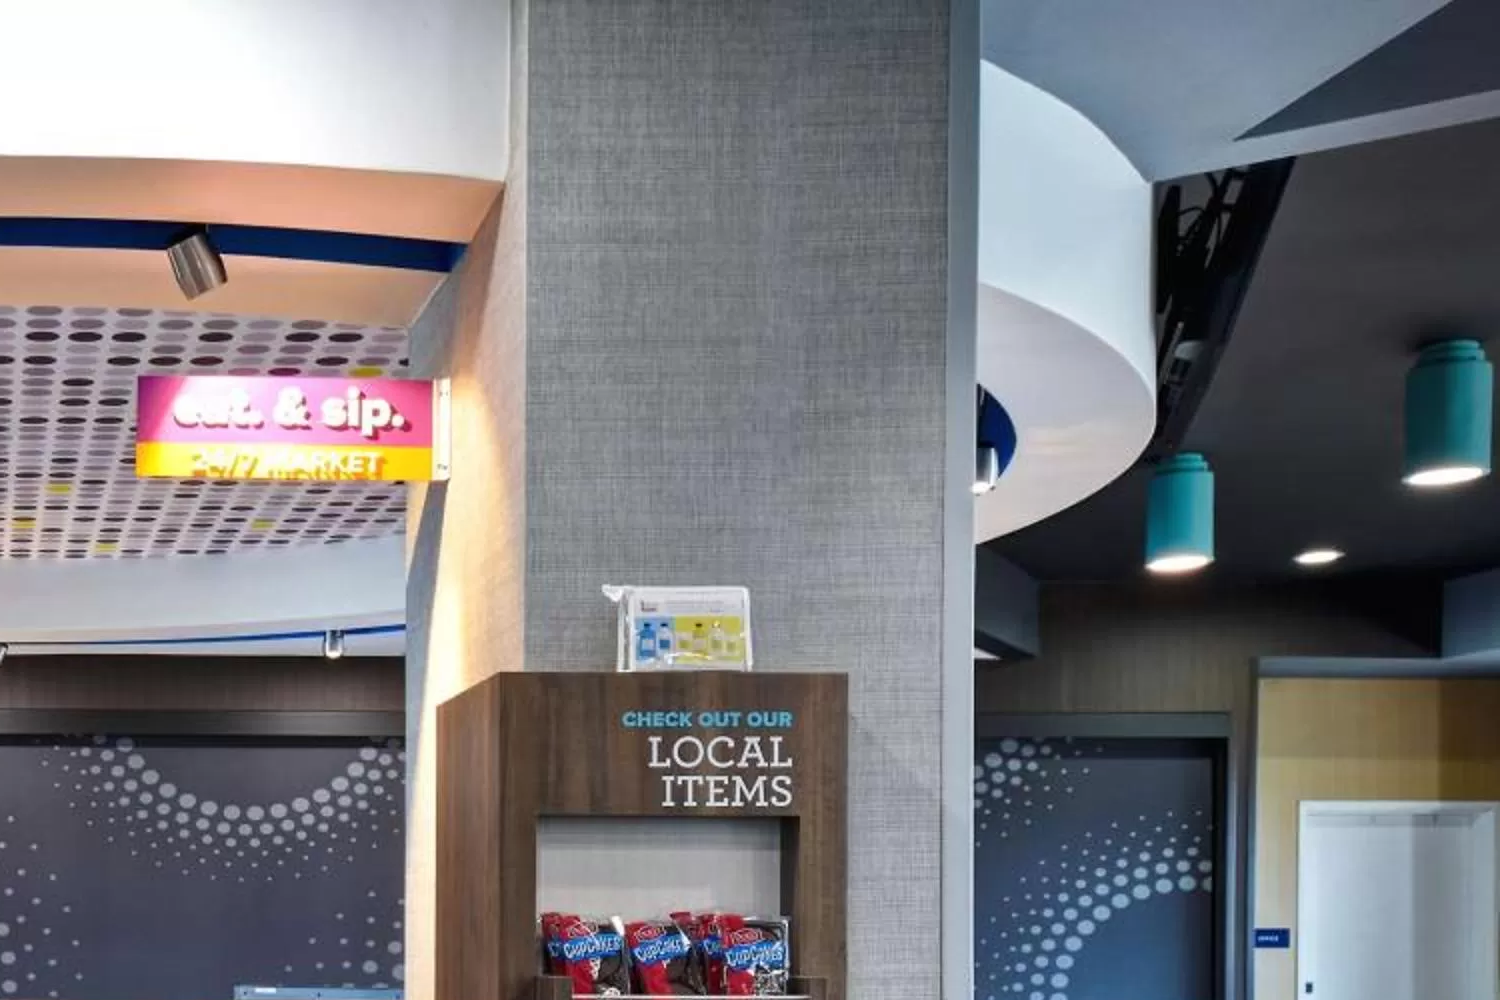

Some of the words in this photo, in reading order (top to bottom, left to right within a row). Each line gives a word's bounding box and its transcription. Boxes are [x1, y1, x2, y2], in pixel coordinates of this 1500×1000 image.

[174, 387, 263, 428] eat.
[273, 386, 311, 427] &
[320, 385, 405, 437] sip.
[264, 449, 384, 477] MARKET
[621, 711, 693, 727] CHECK
[698, 711, 741, 727] OUT
[746, 711, 793, 727] OUR
[647, 735, 793, 769] LOCAL
[660, 775, 793, 808] ITEMS
